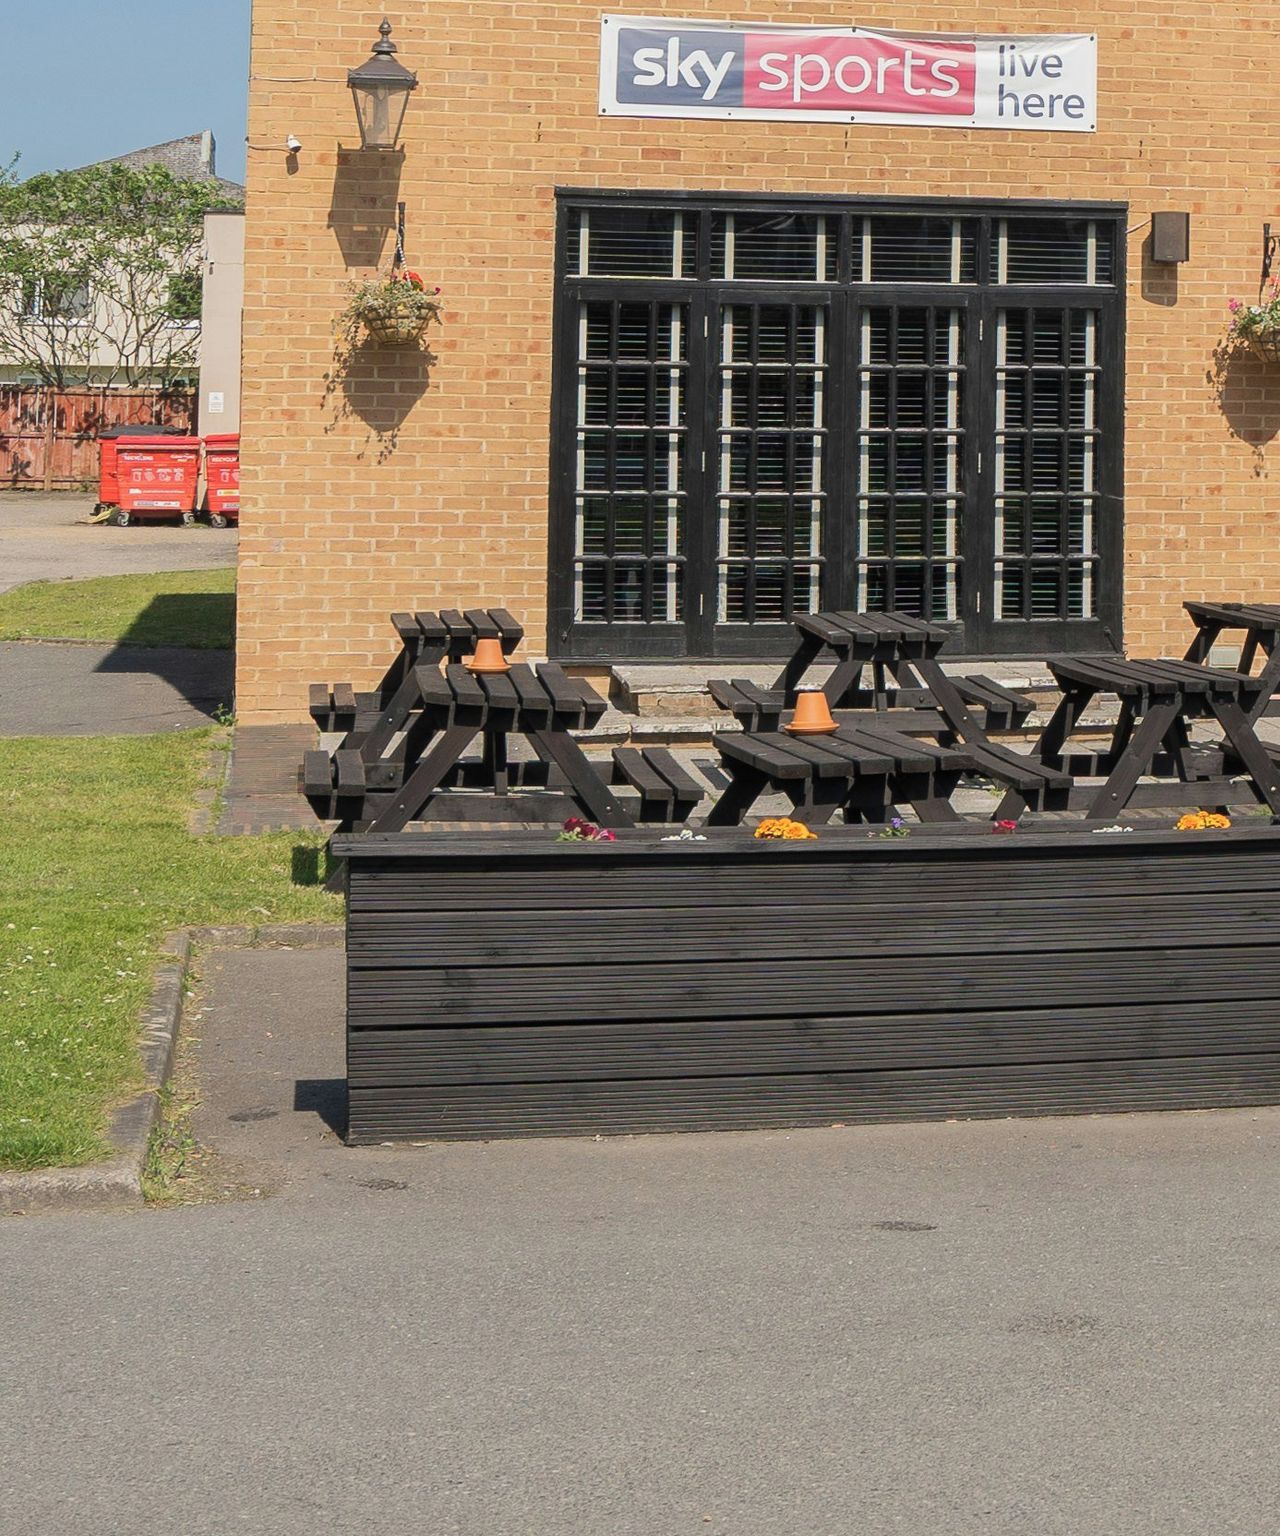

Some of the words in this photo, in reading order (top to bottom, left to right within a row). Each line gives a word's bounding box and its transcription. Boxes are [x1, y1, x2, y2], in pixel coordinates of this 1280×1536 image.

[632, 35, 736, 101] sky
[758, 48, 962, 103] sports
[998, 44, 1063, 79] live
[997, 86, 1085, 120] here
